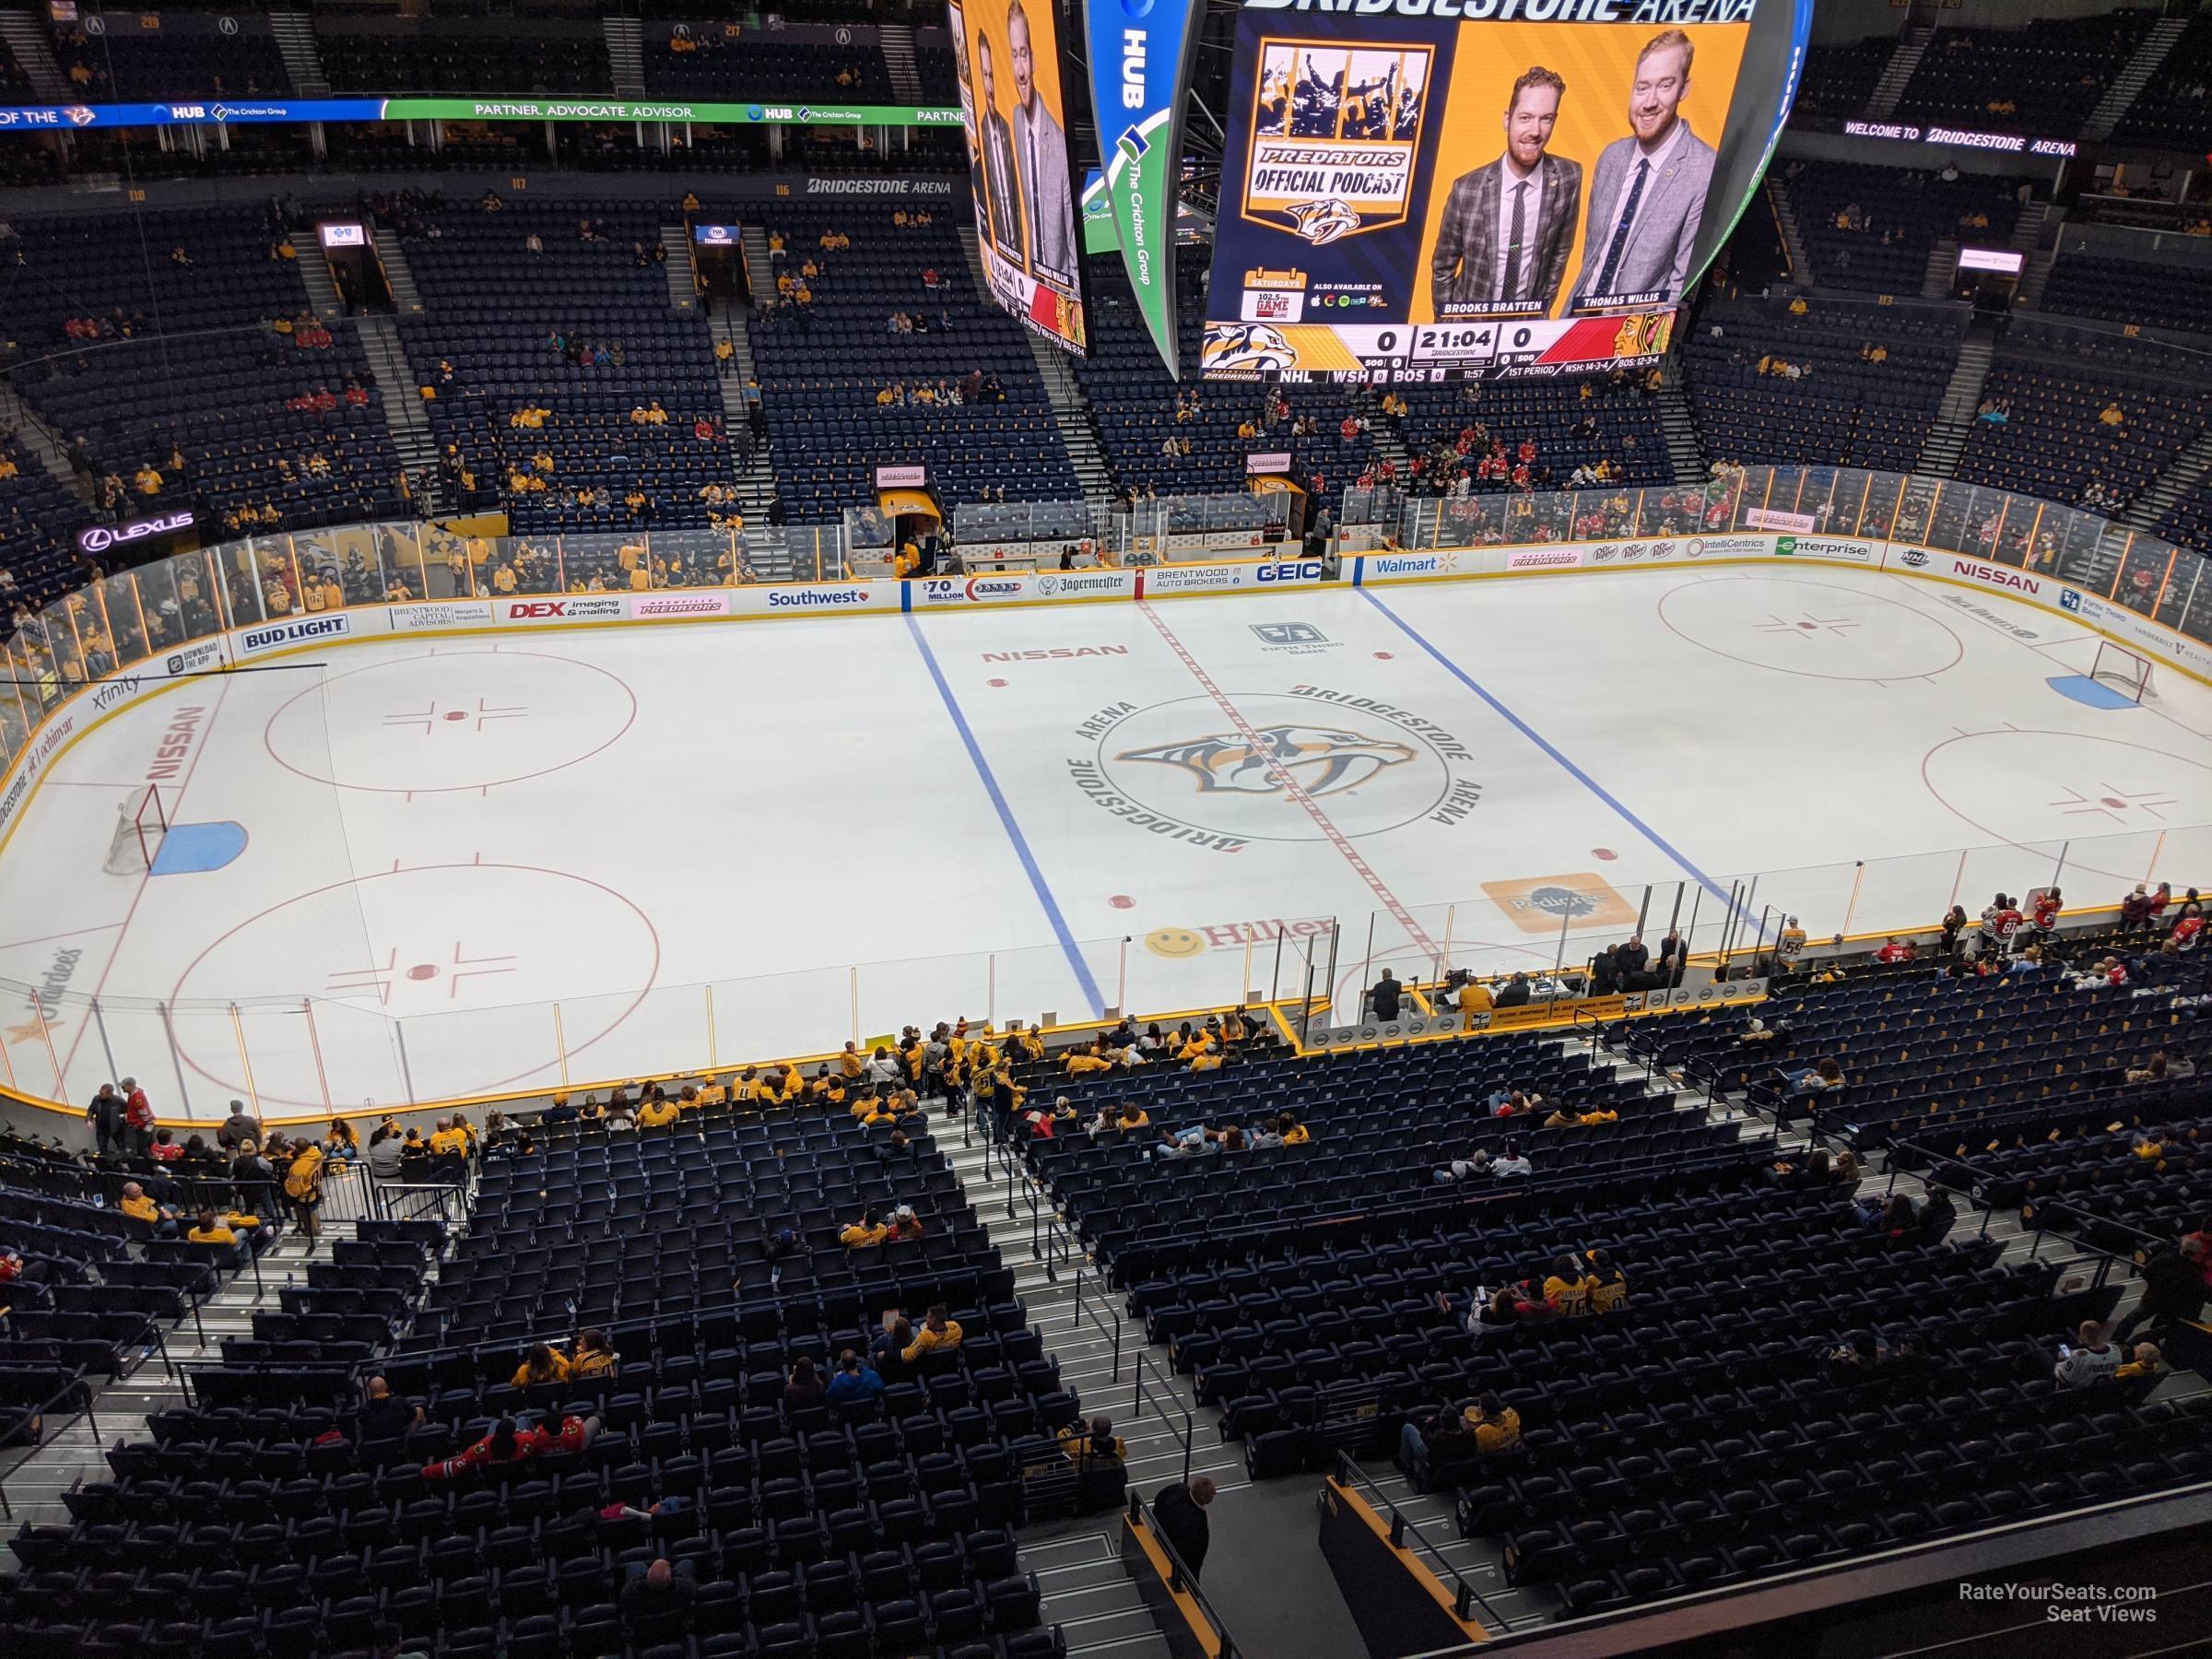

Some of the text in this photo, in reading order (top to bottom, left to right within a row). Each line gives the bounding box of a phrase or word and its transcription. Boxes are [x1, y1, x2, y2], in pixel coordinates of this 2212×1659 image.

[725, 26, 741, 36] 217
[1124, 29, 1147, 109] HUB
[0, 112, 58, 124] OF THE
[172, 107, 205, 119] HUB
[267, 108, 287, 116] Group
[475, 104, 696, 118] PARTNER. ADVOCATE. ADVISOR.
[765, 109, 793, 119] HUB
[812, 111, 821, 119] The
[845, 112, 862, 120] Group
[1845, 122, 2076, 156] WELCOME TO BRIDGESTONE ARENA
[1259, 147, 1406, 167] PREDATORS
[806, 178, 951, 194] BRIDGESTONE ARENA
[1254, 169, 1405, 194] OFFICIAL PODCAST
[1128, 164, 1149, 285] The Crichton Group
[1035, 263, 1069, 286] THOMAS WILLIS
[1252, 279, 1300, 288] SATURDAYS
[1256, 300, 1289, 312] GAME
[1444, 300, 1542, 313] BROOKS BRATTEN
[1584, 293, 1659, 308] THOMAS WILLIS
[1513, 327, 1532, 348] 0
[2124, 325, 2140, 337] 112
[1377, 331, 1397, 352] 0
[1420, 330, 1491, 347] 21:04
[1430, 348, 1477, 357] BRIDGESTONE
[1517, 354, 1535, 362] SOG
[1364, 359, 1383, 367] SOG
[1565, 359, 1608, 373] WSH: 14-3-4
[1618, 355, 1659, 368] BOS: 12-3-4
[1203, 372, 1262, 382] PREDATORS
[1279, 371, 1313, 383] NHL
[1333, 371, 1370, 383] WSH
[1394, 370, 1426, 382] BOS
[1464, 370, 1484, 379] 11:57
[1509, 365, 1555, 377] 1ST PERIOD
[112, 512, 194, 542] LEXUS
[1705, 538, 1765, 549] IntelliCentrics
[1779, 540, 1867, 556] enterprise
[1594, 547, 1618, 559] Pepper
[1623, 546, 1646, 559] Pepper
[1652, 544, 1675, 558] Pepper
[1901, 551, 1928, 563] NHL
[1377, 556, 1437, 573] Walmart
[1512, 556, 1577, 567] PREDATORS
[1157, 568, 1229, 580] BRENTWOOD
[1954, 560, 2040, 594] NISSAN
[923, 580, 951, 593] $70
[1156, 577, 1228, 588] AUTO BROKERS
[309, 594, 323, 605] 92
[769, 589, 858, 606] Southwest
[394, 606, 450, 616] BRENTWOOD
[510, 600, 619, 618] DEX imaging
[579, 607, 620, 616] mailing
[640, 603, 722, 615] PREDATORS
[2081, 606, 2102, 621] BANK
[2084, 599, 2127, 623] FIFTH THIRD
[409, 618, 452, 627] ADVISORS
[245, 618, 344, 649] BUD LIGHT
[2135, 626, 2173, 649] VANDERBILT
[184, 642, 218, 662] DOWNLOAD
[982, 644, 1129, 663] NISSAN
[1261, 641, 1345, 653] FIFTH THIRD
[185, 655, 210, 669] THE APP
[93, 673, 141, 712] xfinity
[1076, 701, 1137, 741] ARENA
[1285, 685, 1473, 762] BRIDGESTONE
[36, 716, 74, 765] Lochinvar
[147, 706, 206, 781] NISSAN
[1067, 759, 1251, 853] BRIDGESTONE
[1430, 778, 1482, 826] ARENA
[1508, 893, 1607, 912] Pedigree
[1201, 918, 1334, 947] Hiller
[1785, 940, 1801, 955] 59
